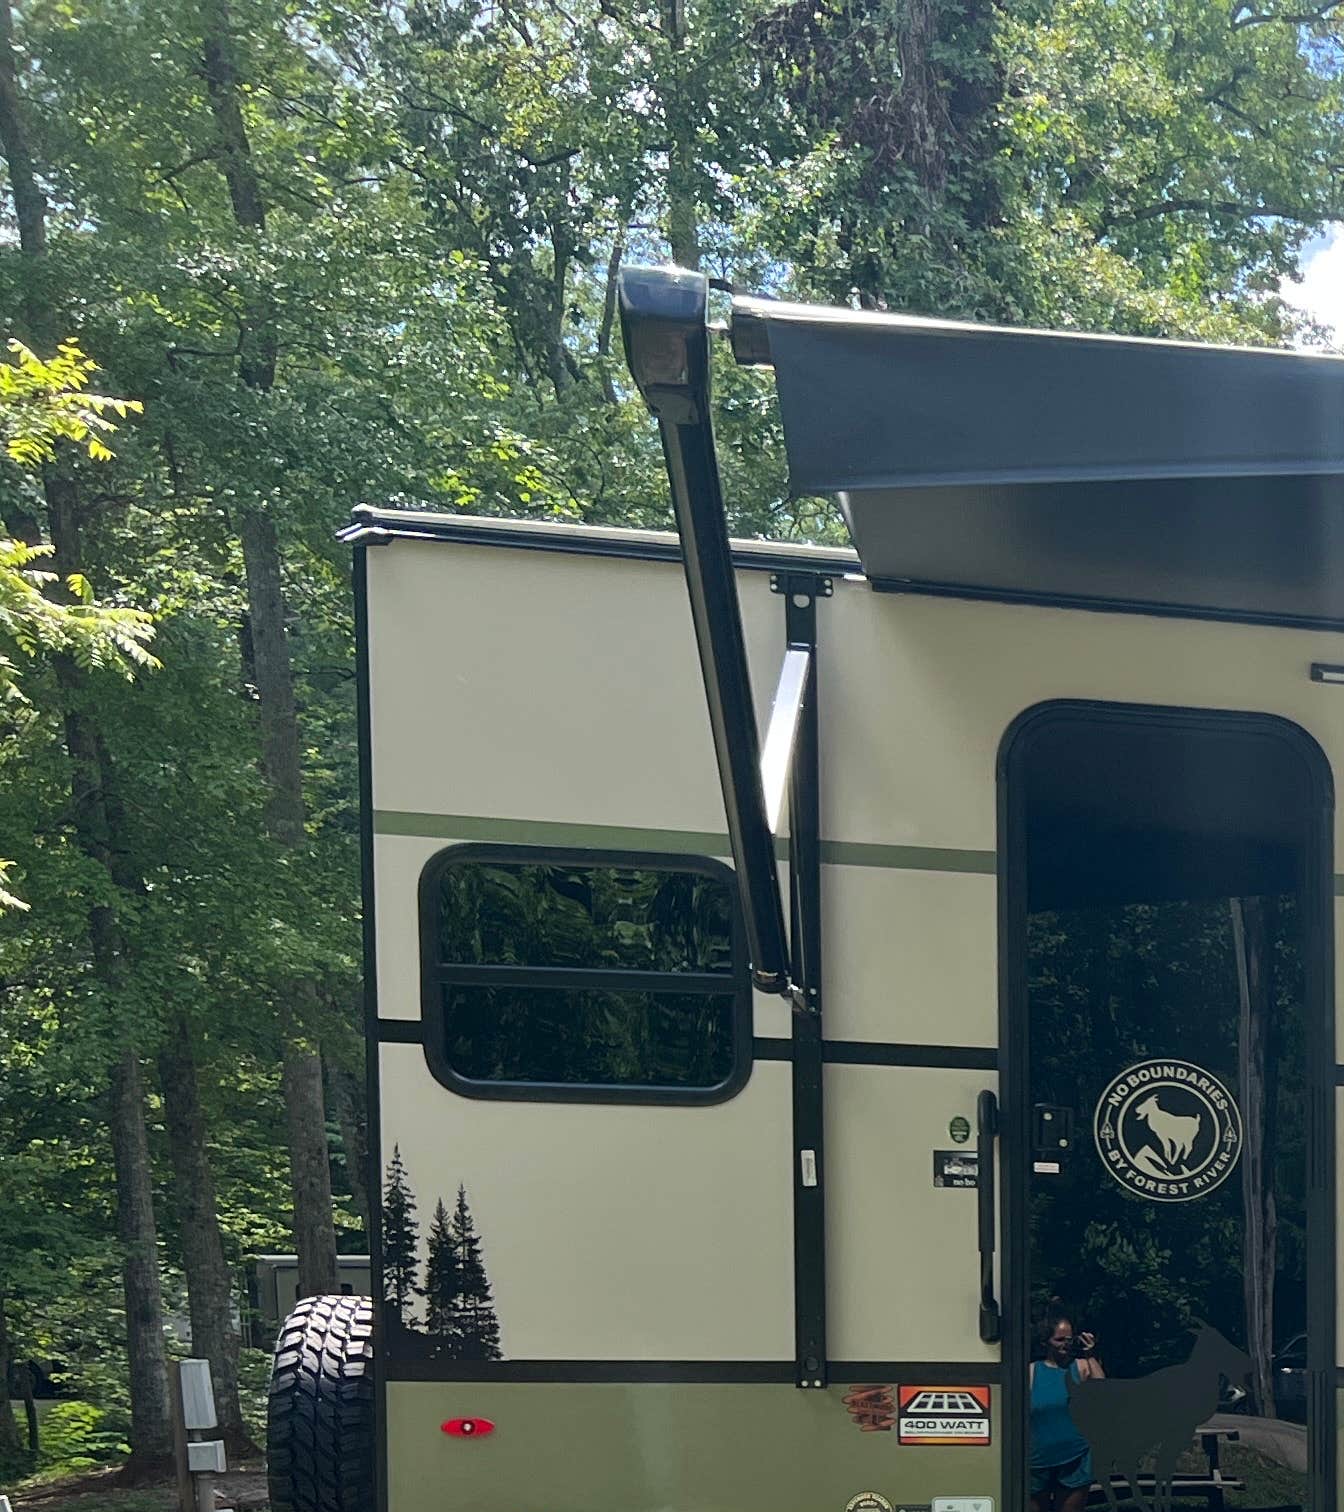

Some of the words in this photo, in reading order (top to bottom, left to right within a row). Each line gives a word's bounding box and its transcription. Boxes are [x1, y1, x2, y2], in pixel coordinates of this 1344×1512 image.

[1109, 1084, 1129, 1107] NO
[1127, 1066, 1229, 1111] BOUNDARIES
[1108, 1149, 1128, 1173] BY
[1126, 1169, 1191, 1196] FOREST
[1193, 1151, 1231, 1189] RIVER
[904, 1420, 937, 1430] 400
[937, 1420, 985, 1430] WATT
